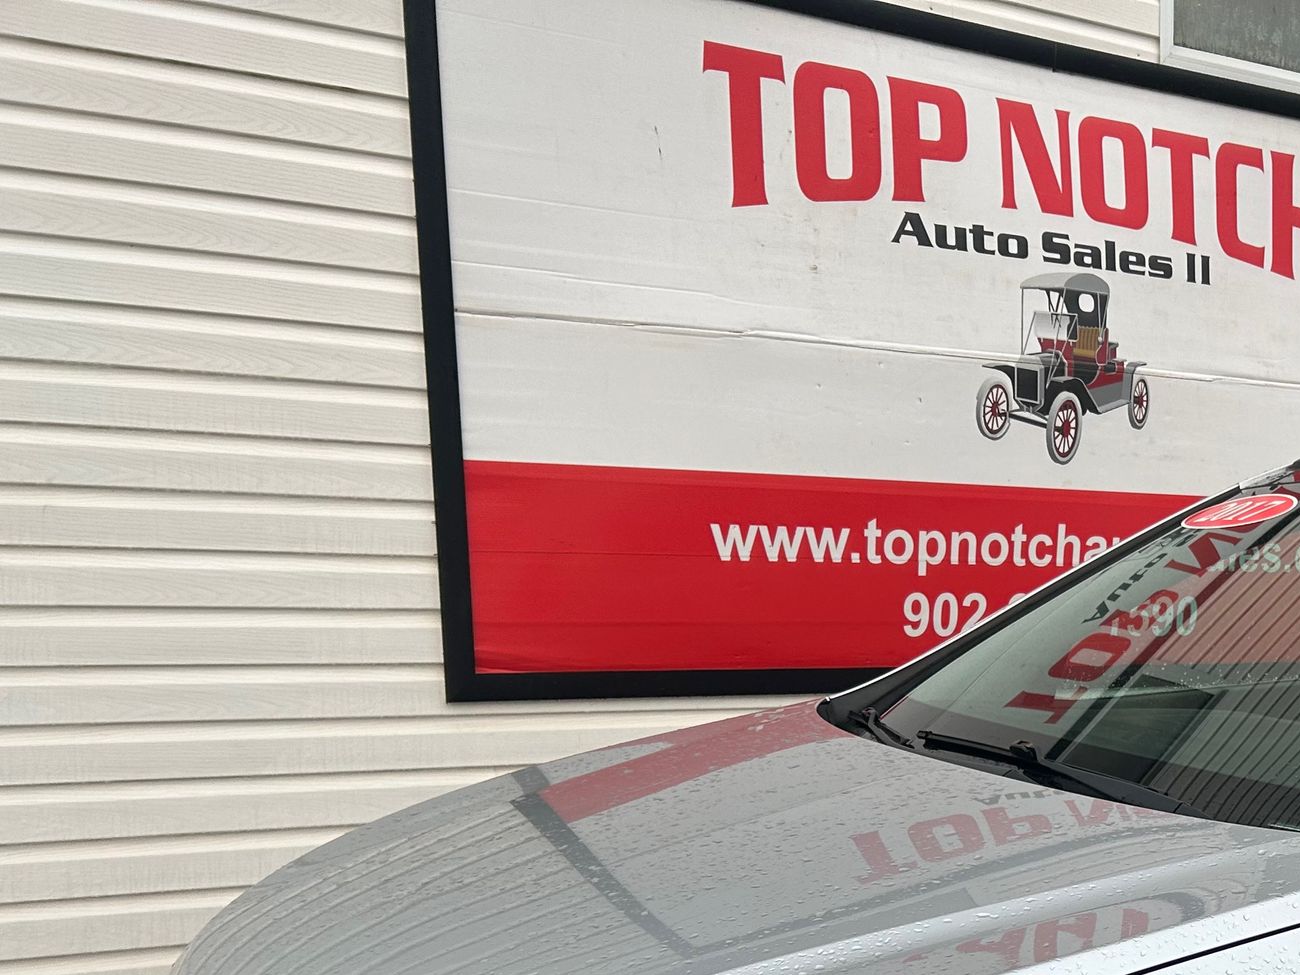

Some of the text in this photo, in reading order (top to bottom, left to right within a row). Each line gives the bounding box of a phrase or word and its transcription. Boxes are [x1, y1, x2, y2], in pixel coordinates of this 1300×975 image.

[703, 41, 968, 207] TOP
[891, 211, 1029, 259] Auto
[1041, 231, 1173, 280] Sales
[1193, 500, 1287, 523] 2017
